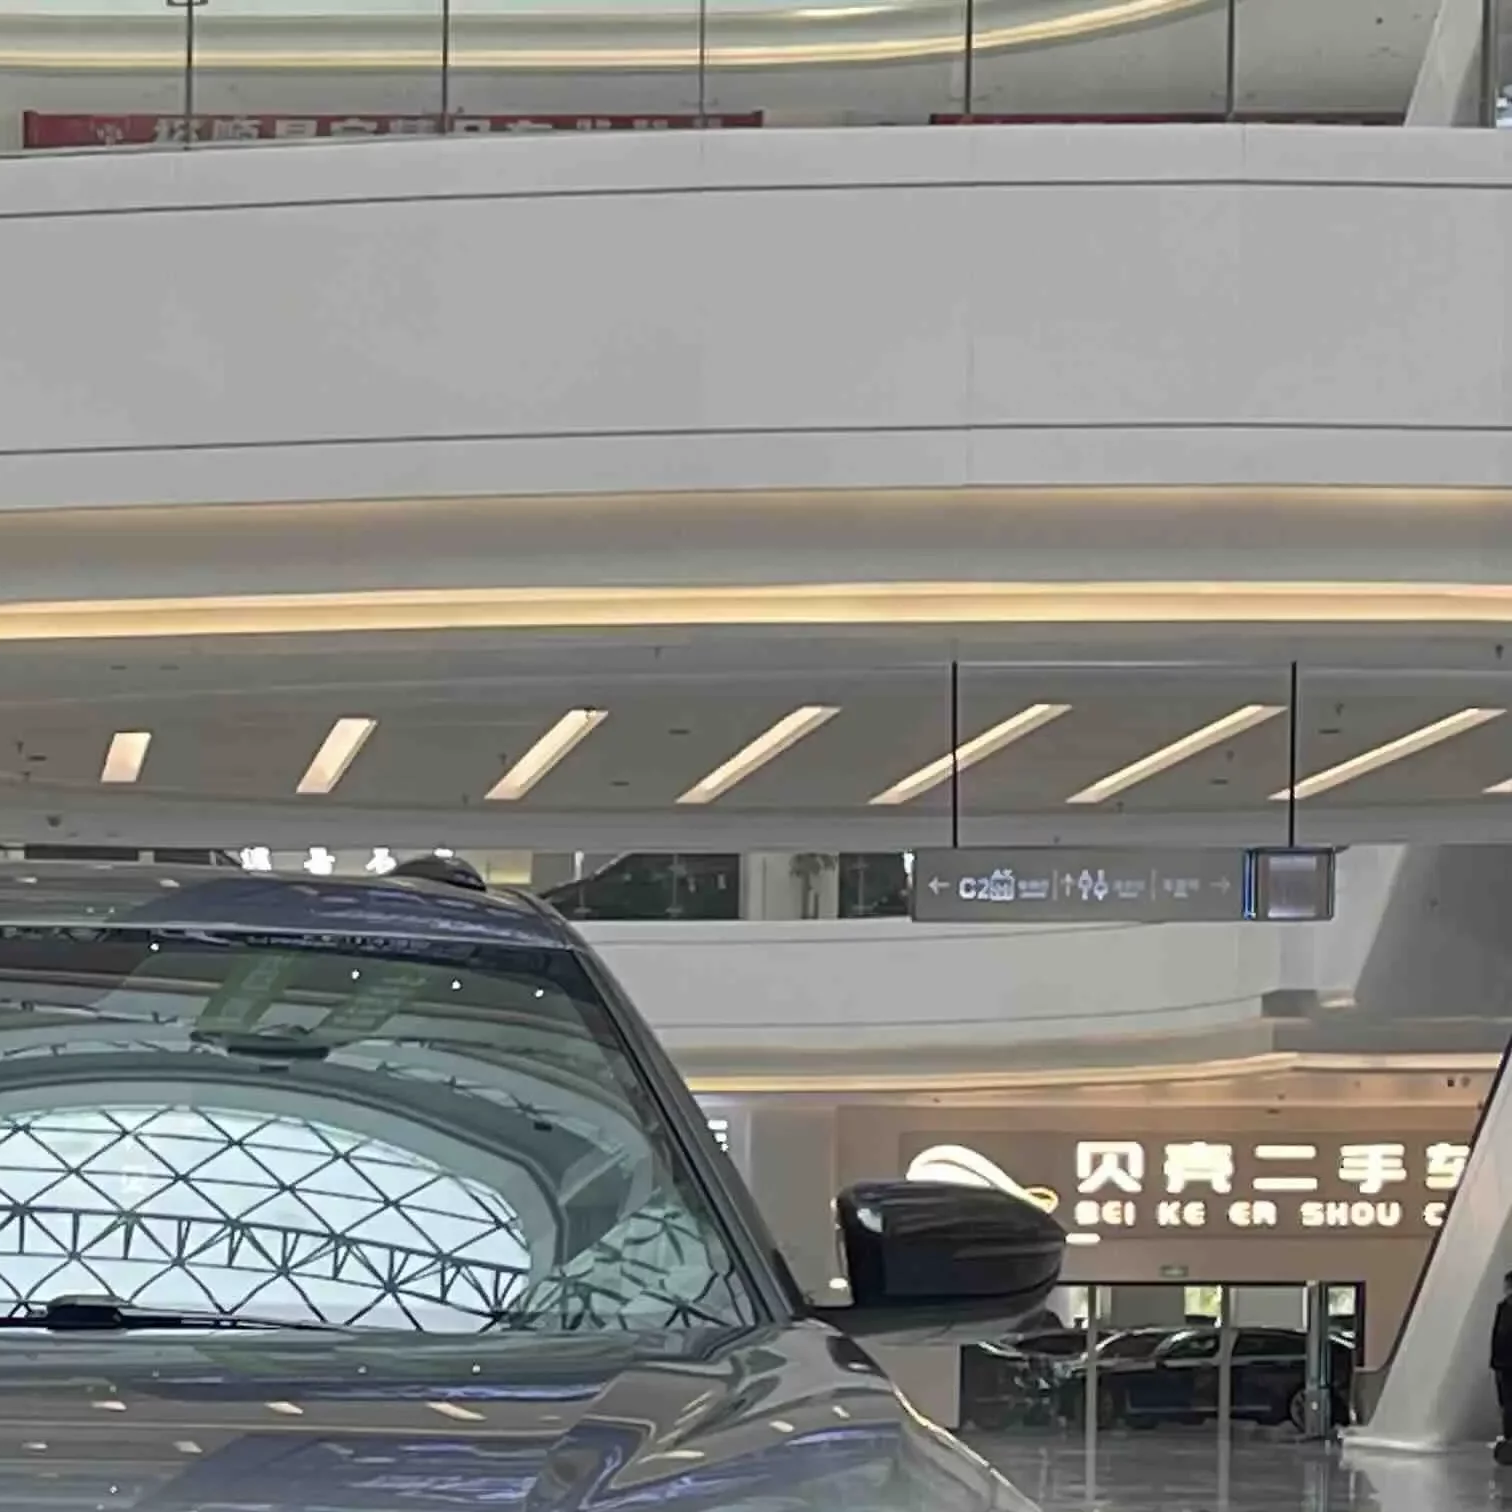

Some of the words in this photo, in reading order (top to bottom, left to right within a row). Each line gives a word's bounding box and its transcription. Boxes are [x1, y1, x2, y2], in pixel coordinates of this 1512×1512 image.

[1074, 1200, 1136, 1226] BEI
[1157, 1200, 1206, 1226] KE
[1228, 1200, 1277, 1226] ER
[1300, 1200, 1402, 1227] SHOU
